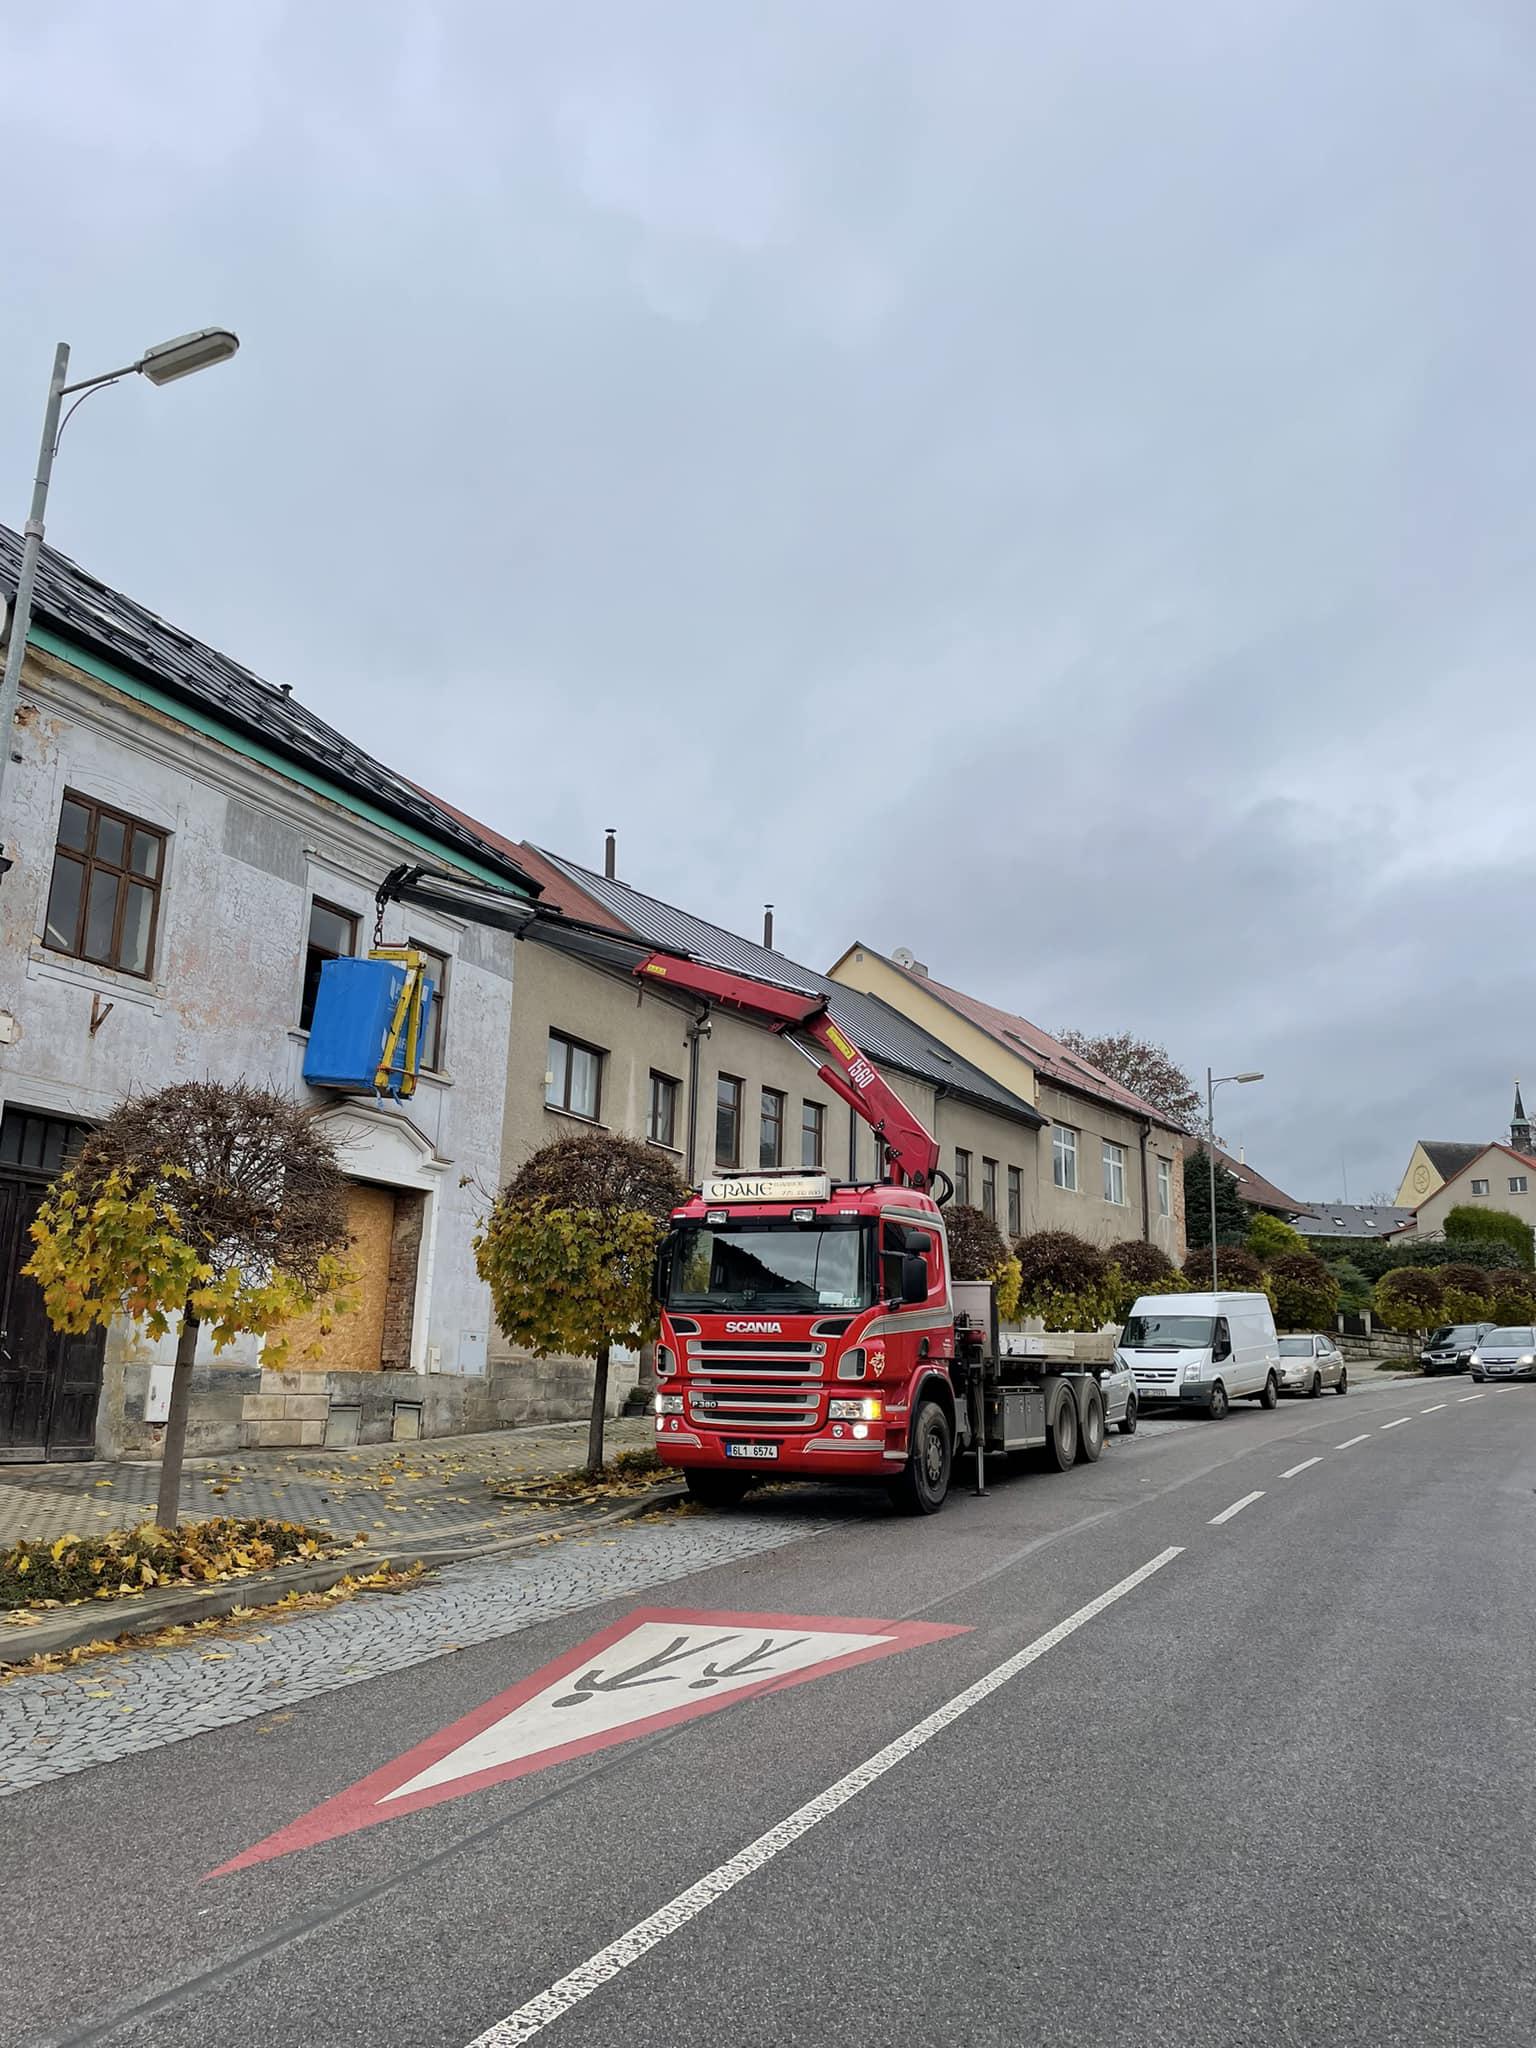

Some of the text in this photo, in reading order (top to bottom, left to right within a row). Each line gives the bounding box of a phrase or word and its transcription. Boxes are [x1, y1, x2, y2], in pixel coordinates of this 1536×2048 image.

[847, 1058, 876, 1089] 1560
[711, 1182, 773, 1199] CRANE
[725, 1321, 782, 1334] SCANIA
[732, 1446, 774, 1457] 6L1 6574
